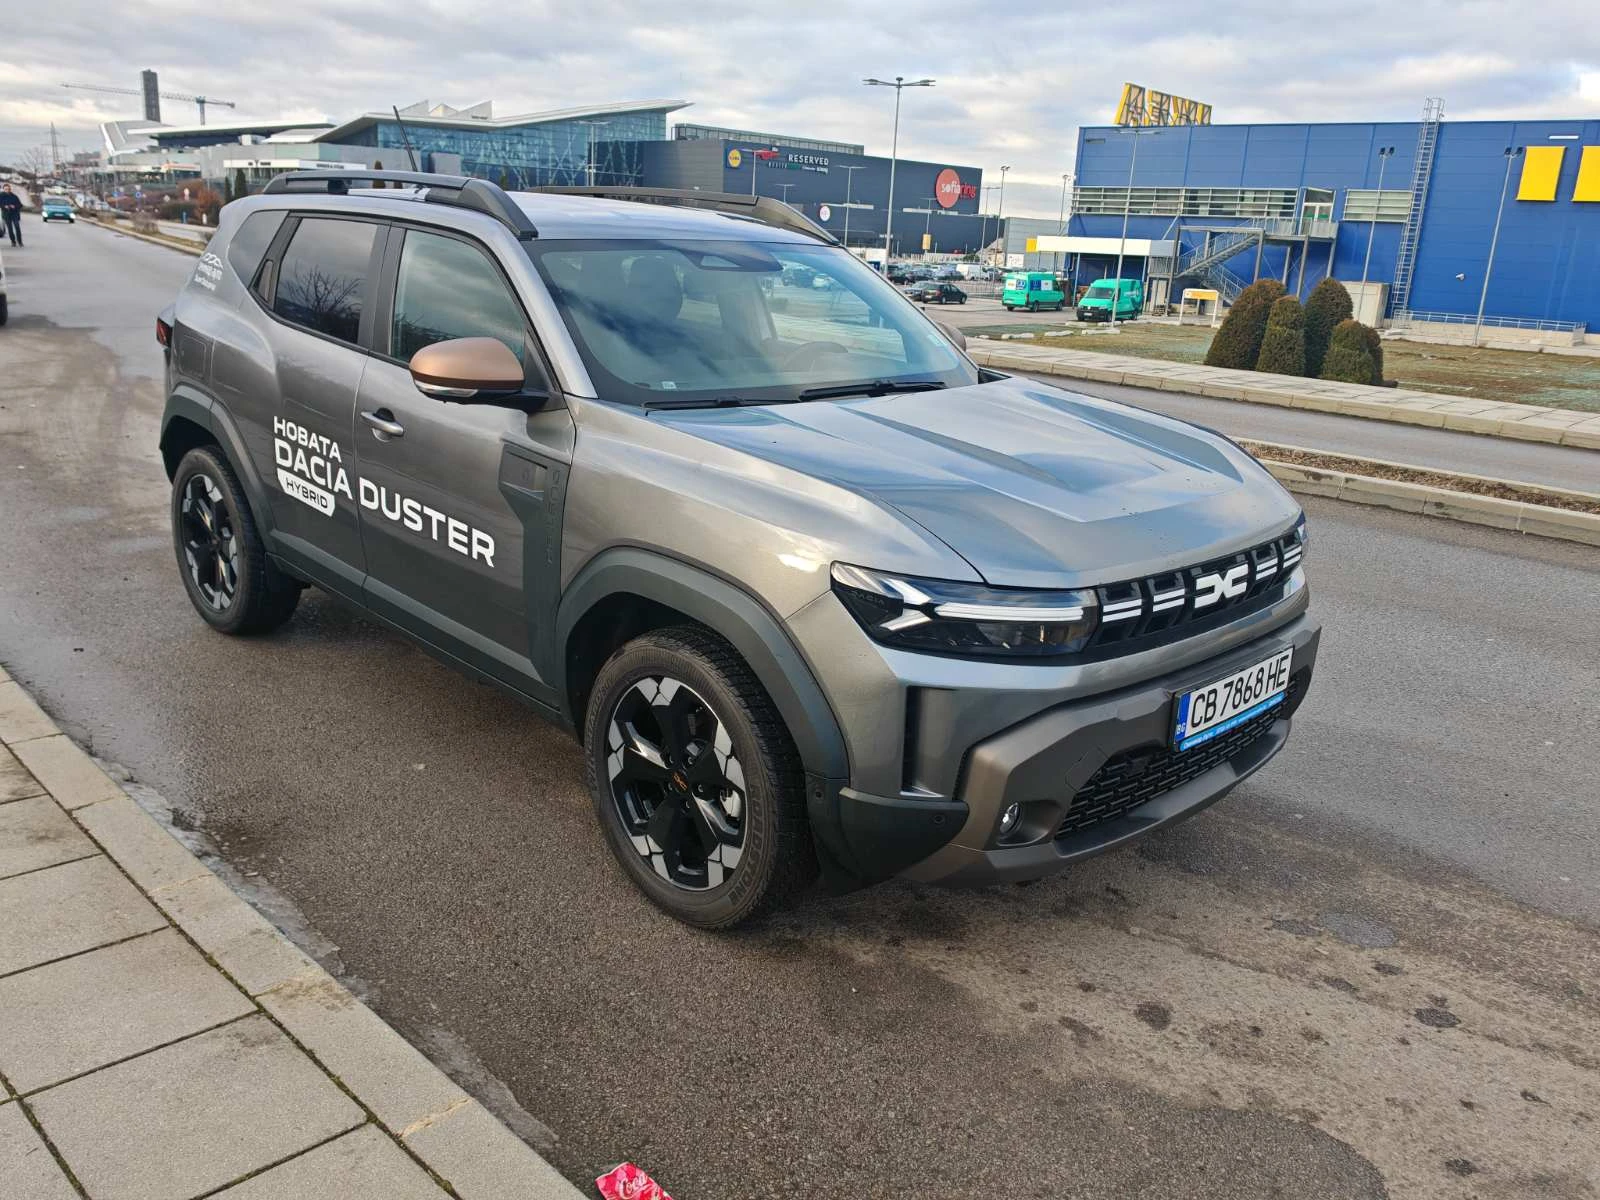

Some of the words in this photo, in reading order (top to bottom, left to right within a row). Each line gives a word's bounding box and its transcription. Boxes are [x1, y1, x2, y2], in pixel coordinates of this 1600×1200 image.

[788, 154, 829, 165] RESERVED
[274, 438, 353, 500] DACIA
[359, 476, 495, 568] DUSTER
[285, 476, 328, 509] HYBRID
[1220, 666, 1265, 717] 7868
